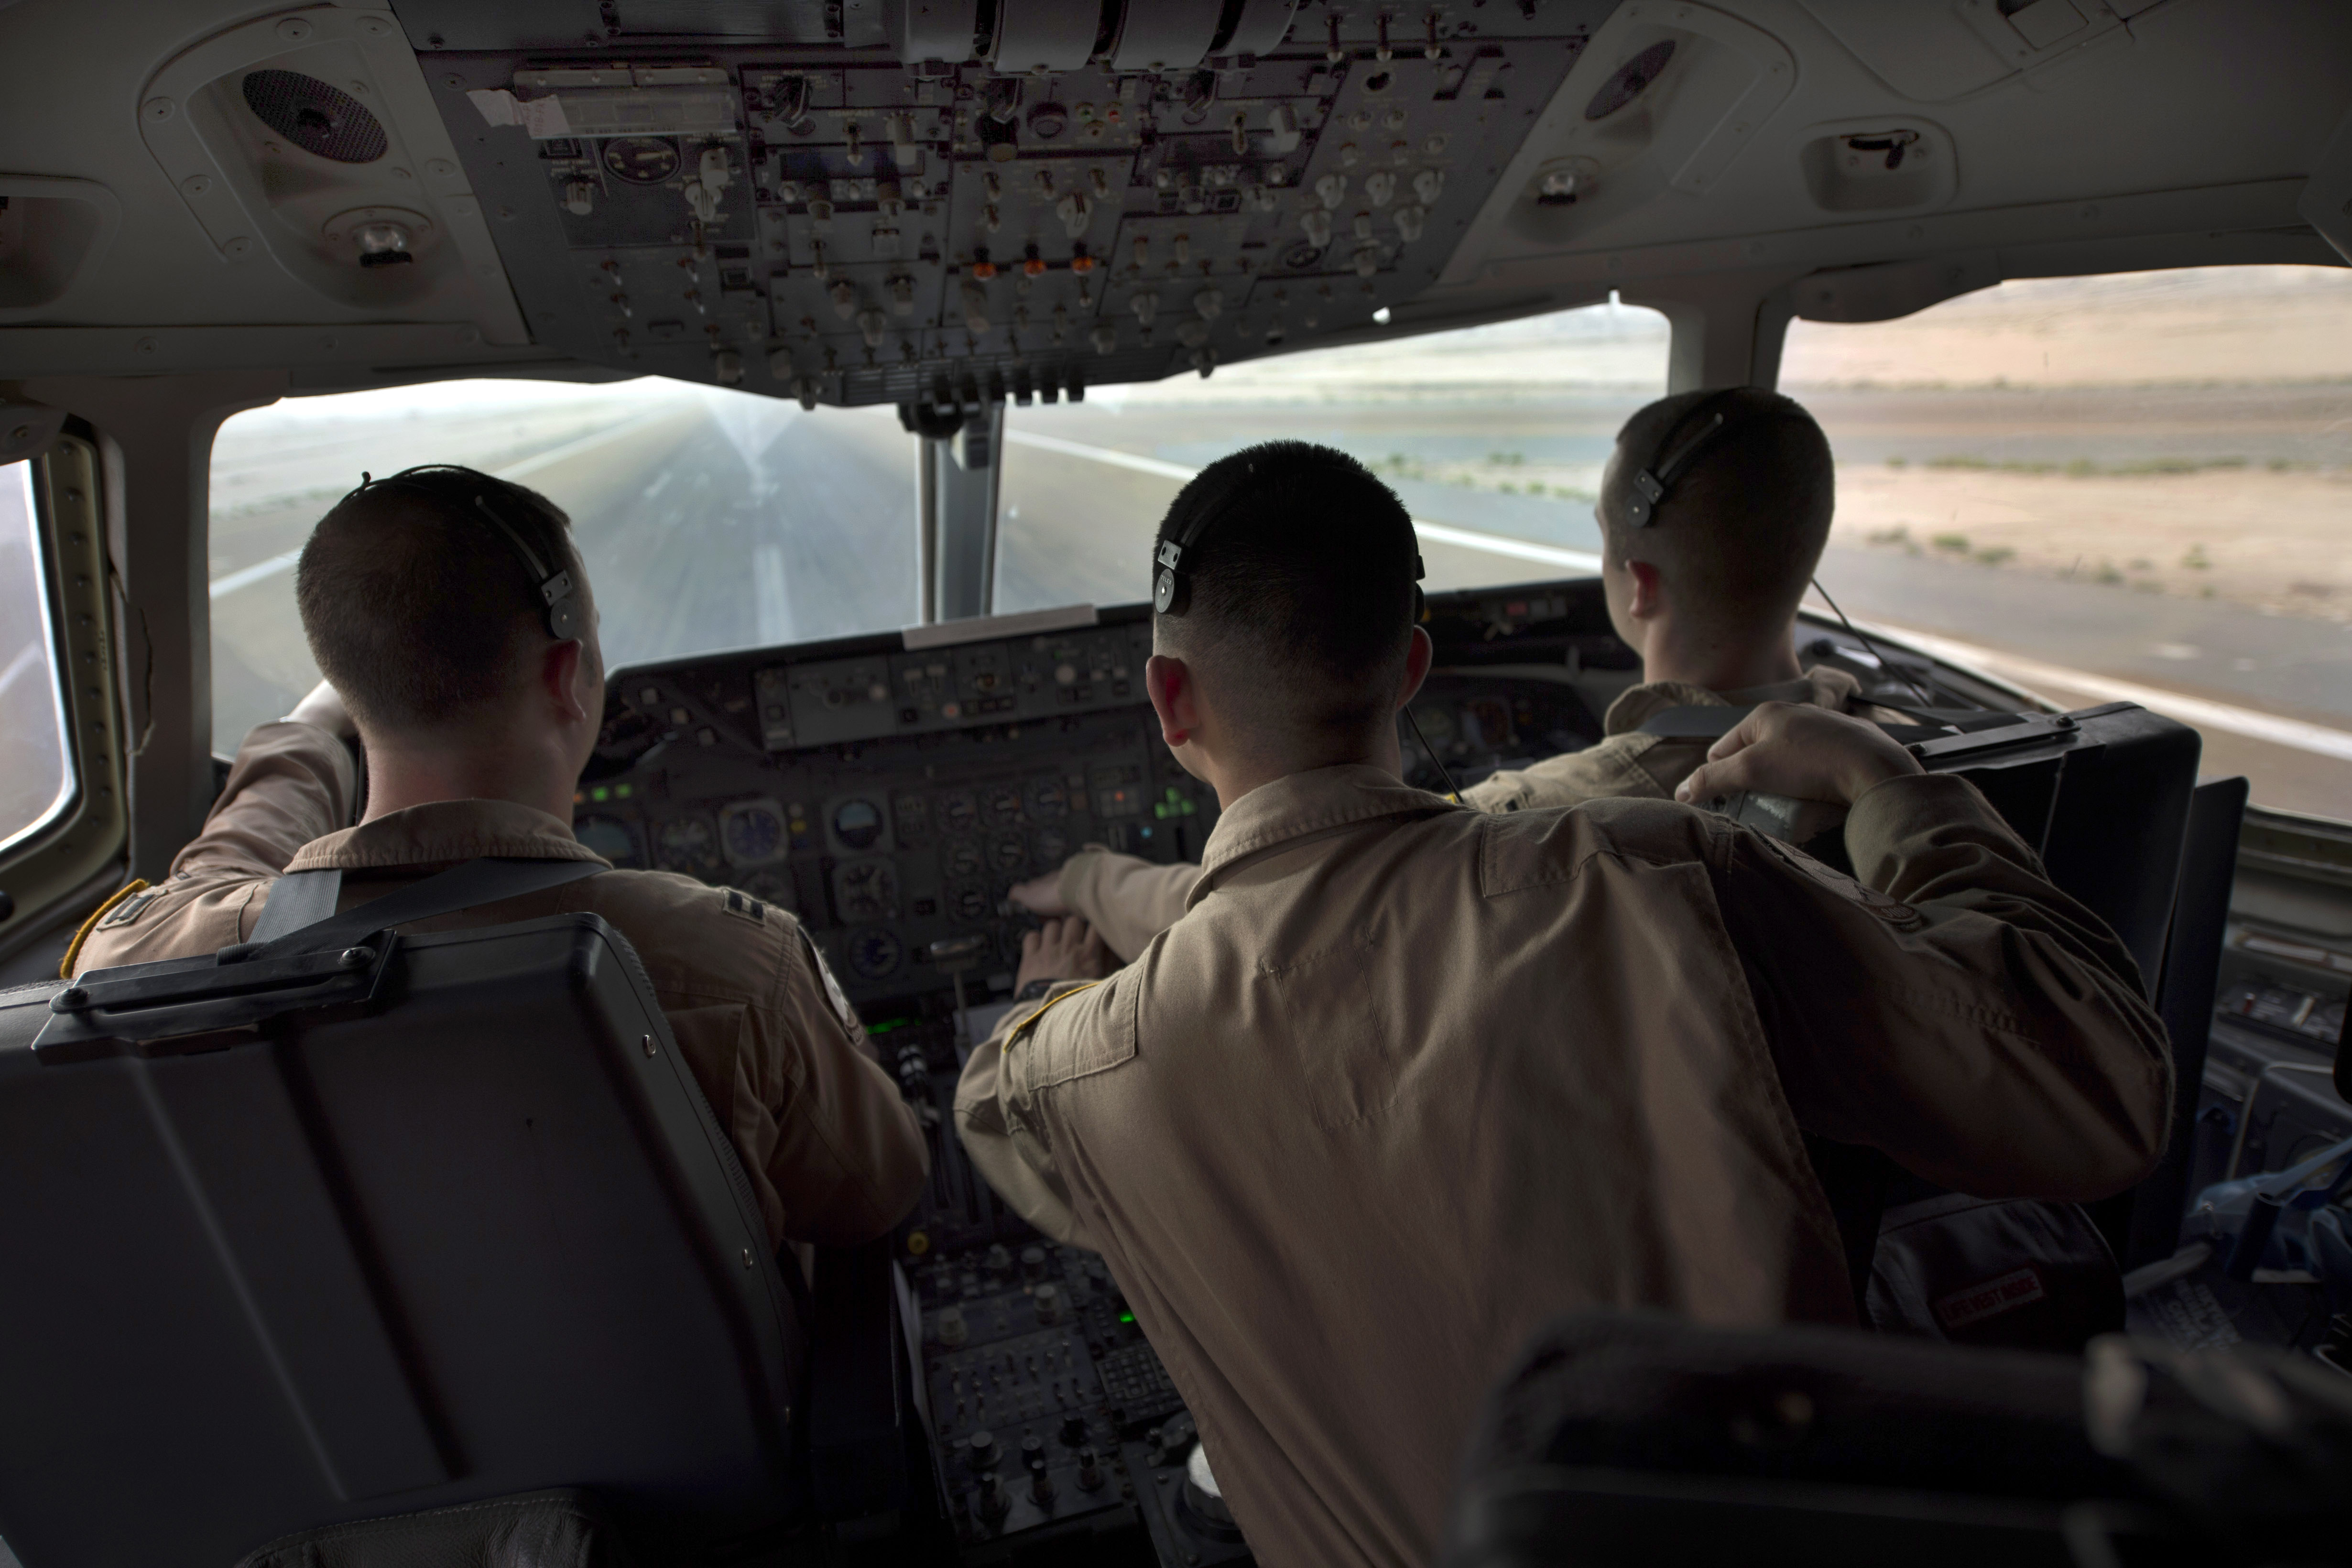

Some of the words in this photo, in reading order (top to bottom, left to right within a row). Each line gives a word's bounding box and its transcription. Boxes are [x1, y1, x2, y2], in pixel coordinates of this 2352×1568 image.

[1939, 1298, 1973, 1322] LIFE
[1969, 1289, 2003, 1312] VEST
[2000, 1276, 2039, 1300] INSIDE
